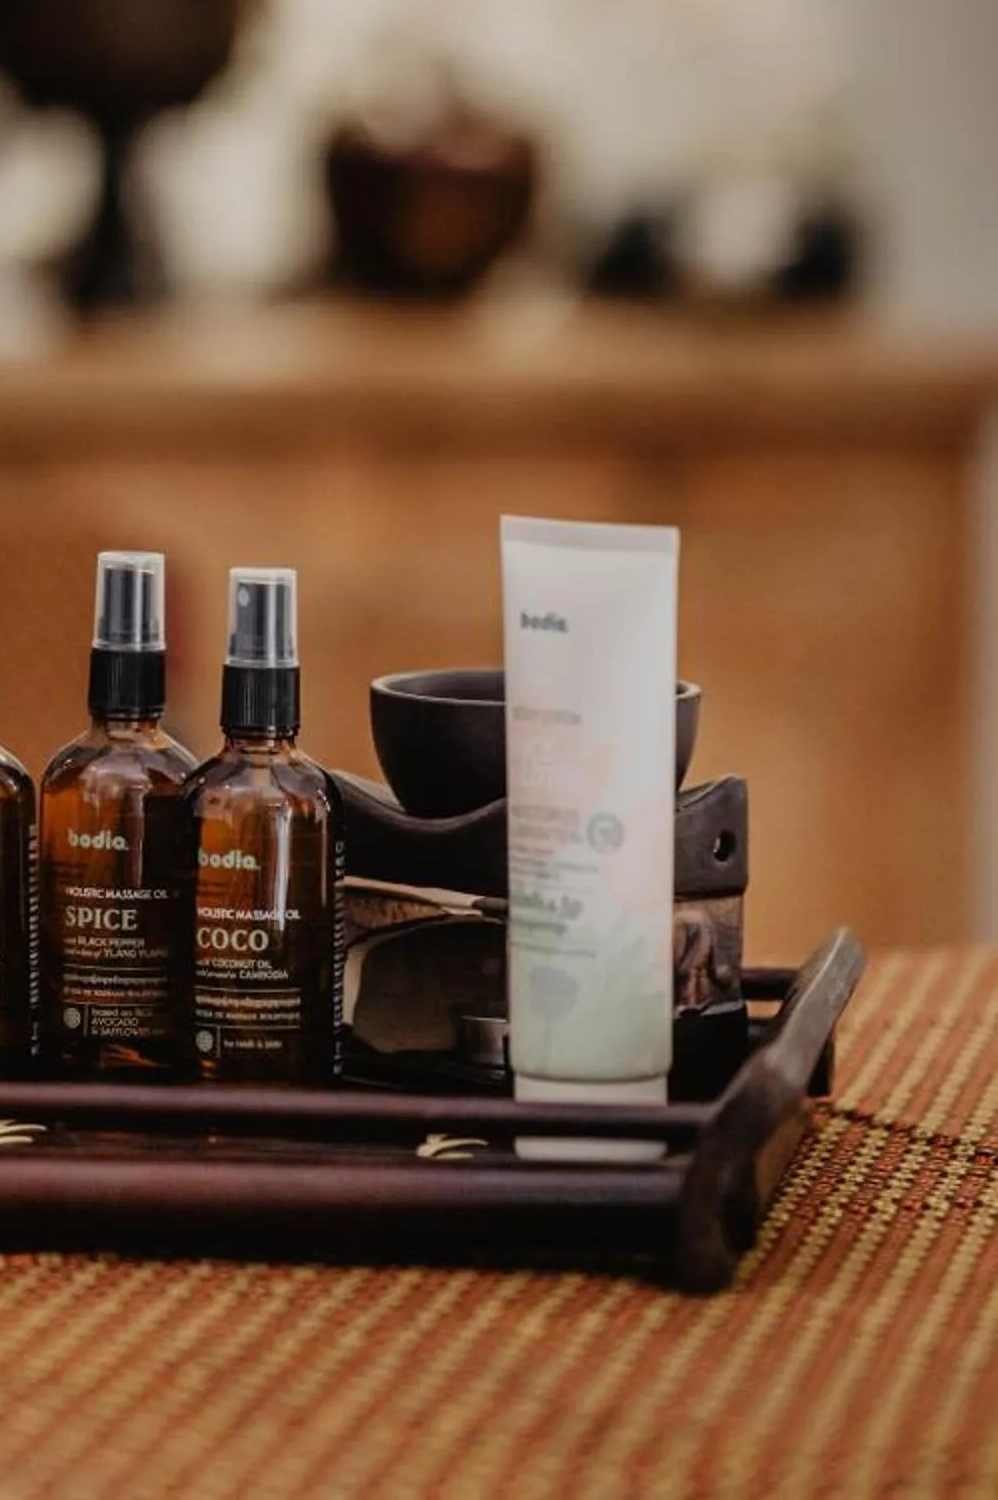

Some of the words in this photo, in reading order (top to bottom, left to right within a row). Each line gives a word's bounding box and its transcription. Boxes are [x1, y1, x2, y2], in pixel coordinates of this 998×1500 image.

[65, 886, 104, 898] HOLISTIC
[105, 888, 152, 900] MASSAGE
[153, 889, 168, 899] OIL
[65, 905, 138, 931] SPICE
[285, 909, 301, 920] OIL
[197, 927, 269, 951] COCO
[90, 1017, 139, 1027] AVOCADO
